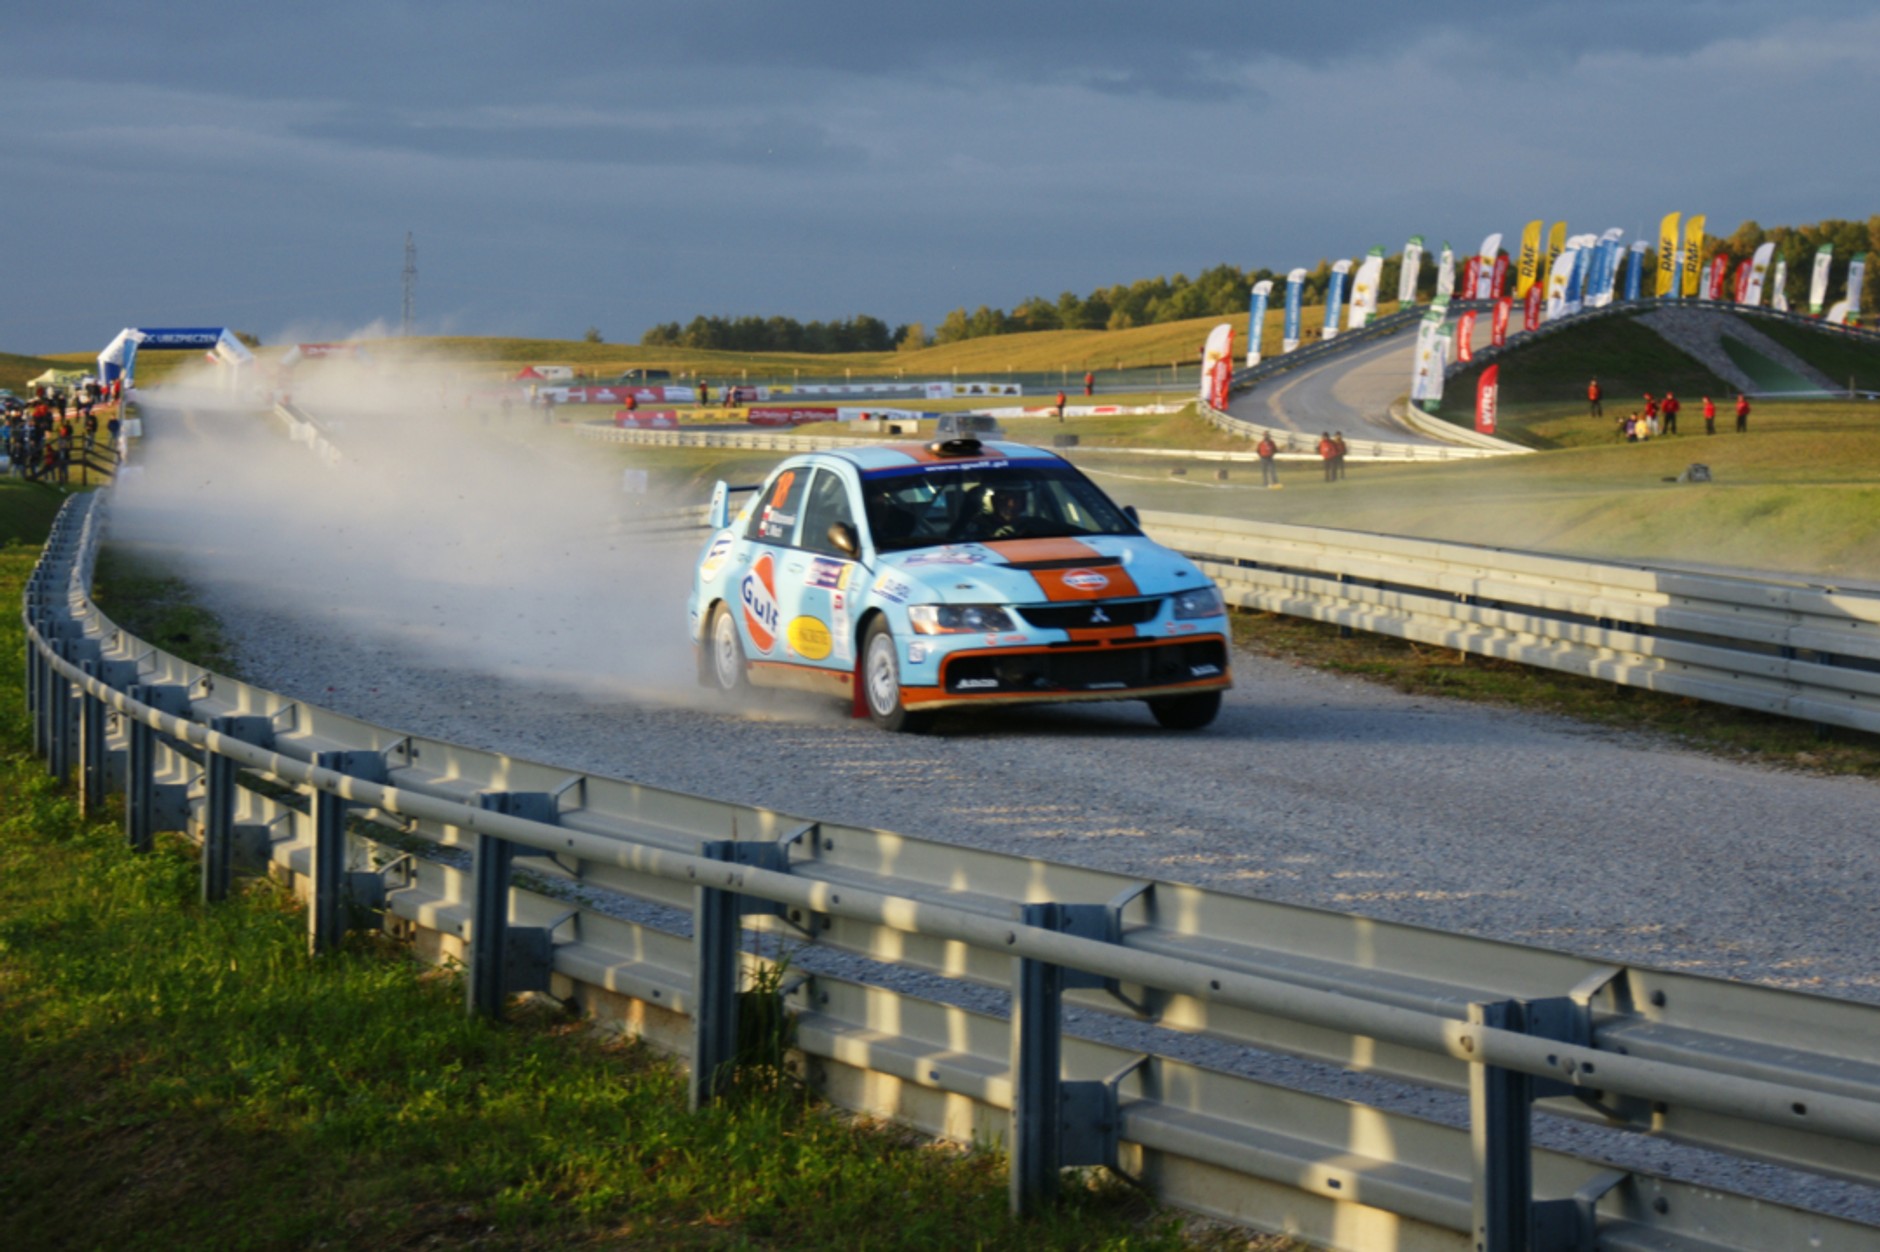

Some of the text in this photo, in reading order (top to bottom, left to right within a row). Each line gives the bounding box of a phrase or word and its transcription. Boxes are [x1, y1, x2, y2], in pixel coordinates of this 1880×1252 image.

[1521, 244, 1537, 278] RMF
[1661, 236, 1674, 273] RMF
[1687, 239, 1699, 273] RMF
[1482, 385, 1494, 425] WRC
[742, 574, 780, 632] Gulf
